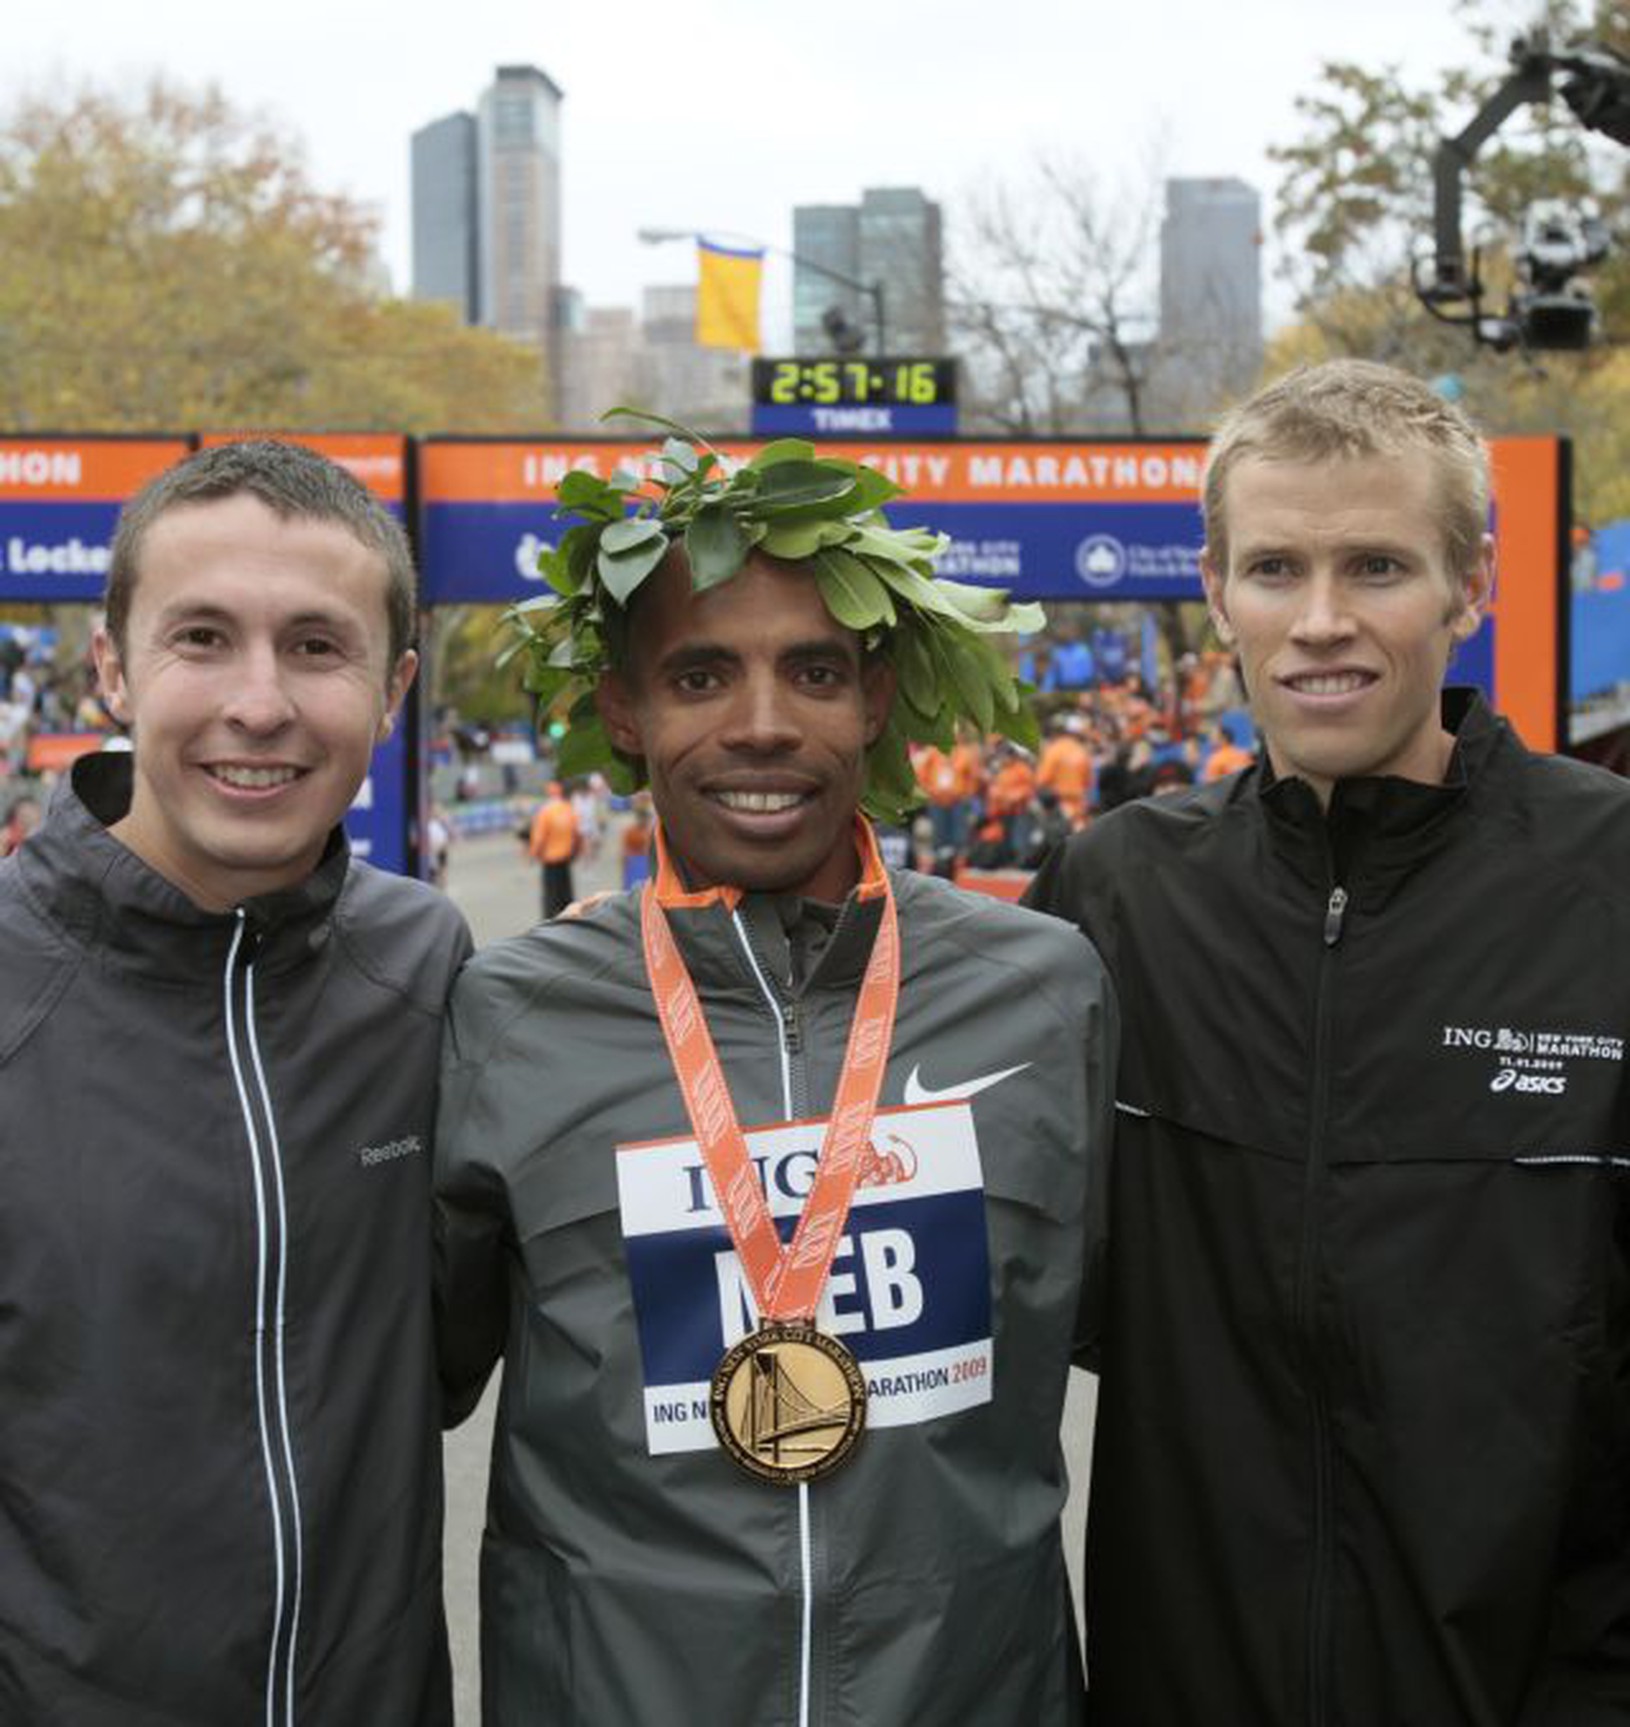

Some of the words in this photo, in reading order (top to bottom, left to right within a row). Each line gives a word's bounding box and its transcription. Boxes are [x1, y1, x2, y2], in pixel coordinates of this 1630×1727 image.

[811, 407, 893, 430] TIMEX
[969, 456, 1199, 488] MARATHON
[8, 537, 113, 574] Locke
[1442, 1027, 1492, 1048] ING
[1537, 1033, 1561, 1043] NEW
[1564, 1035, 1595, 1044] YORK
[1597, 1036, 1624, 1047] CITY
[1537, 1042, 1623, 1060] MARATHON
[653, 1402, 687, 1423] ING
[868, 1367, 949, 1397] ARATHON
[951, 1356, 987, 1384] 2009
